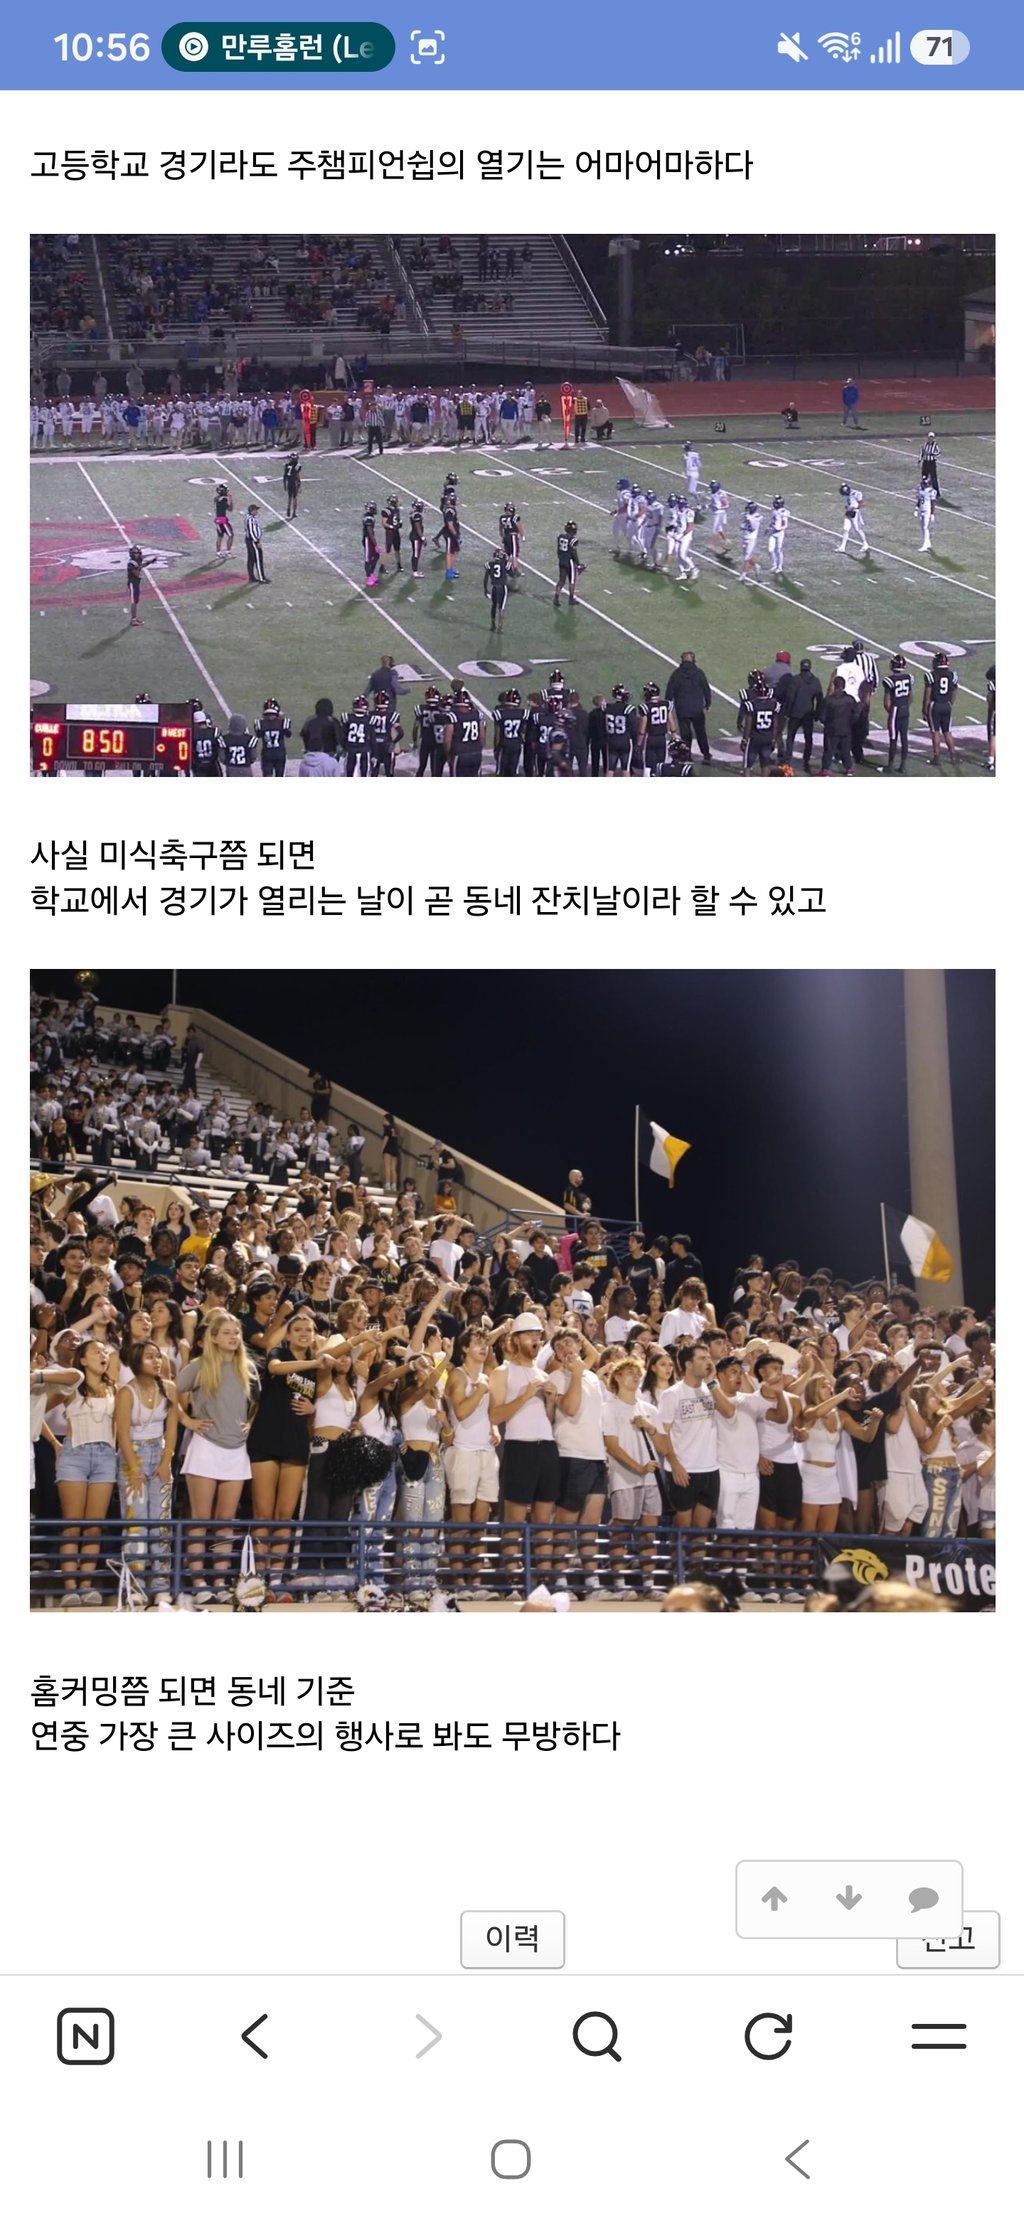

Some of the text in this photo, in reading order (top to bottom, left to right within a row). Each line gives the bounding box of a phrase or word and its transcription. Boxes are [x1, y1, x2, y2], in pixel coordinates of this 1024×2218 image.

[54, 32, 150, 62] 10:56
[222, 32, 375, 64] 만루홈런 (Le
[926, 36, 953, 57] 71
[30, 149, 754, 181] 고등학교 경기라도 주챔피언쉽의 열기는 어마어마하다
[493, 564, 501, 578] 3
[895, 679, 910, 698] 25
[940, 677, 949, 695] 9
[605, 713, 626, 734] 69
[650, 705, 668, 725] 20
[756, 711, 773, 730] 55
[347, 722, 366, 743] 24
[462, 720, 479, 742] 78
[504, 719, 521, 739] 27
[42, 736, 53, 757] 0
[82, 729, 124, 754] 8:50
[178, 741, 188, 761] 0
[53, 760, 77, 770] DOWN
[228, 745, 246, 765] 72
[30, 838, 315, 872] 사실 미식축구쯤 되면
[30, 885, 827, 917] 학교에서 경기가 열리는 날이 곧 동네 잔치날이라 할 수 있고
[905, 1554, 996, 1596] Prote
[30, 1675, 355, 1708] 홈커밍쯤 되면 동네 기준
[31, 1720, 621, 1752] 연중 가장 큰 사이즈의 행사로 봐도 무방하다
[486, 1924, 538, 1953] 이력
[72, 2023, 99, 2050] N
